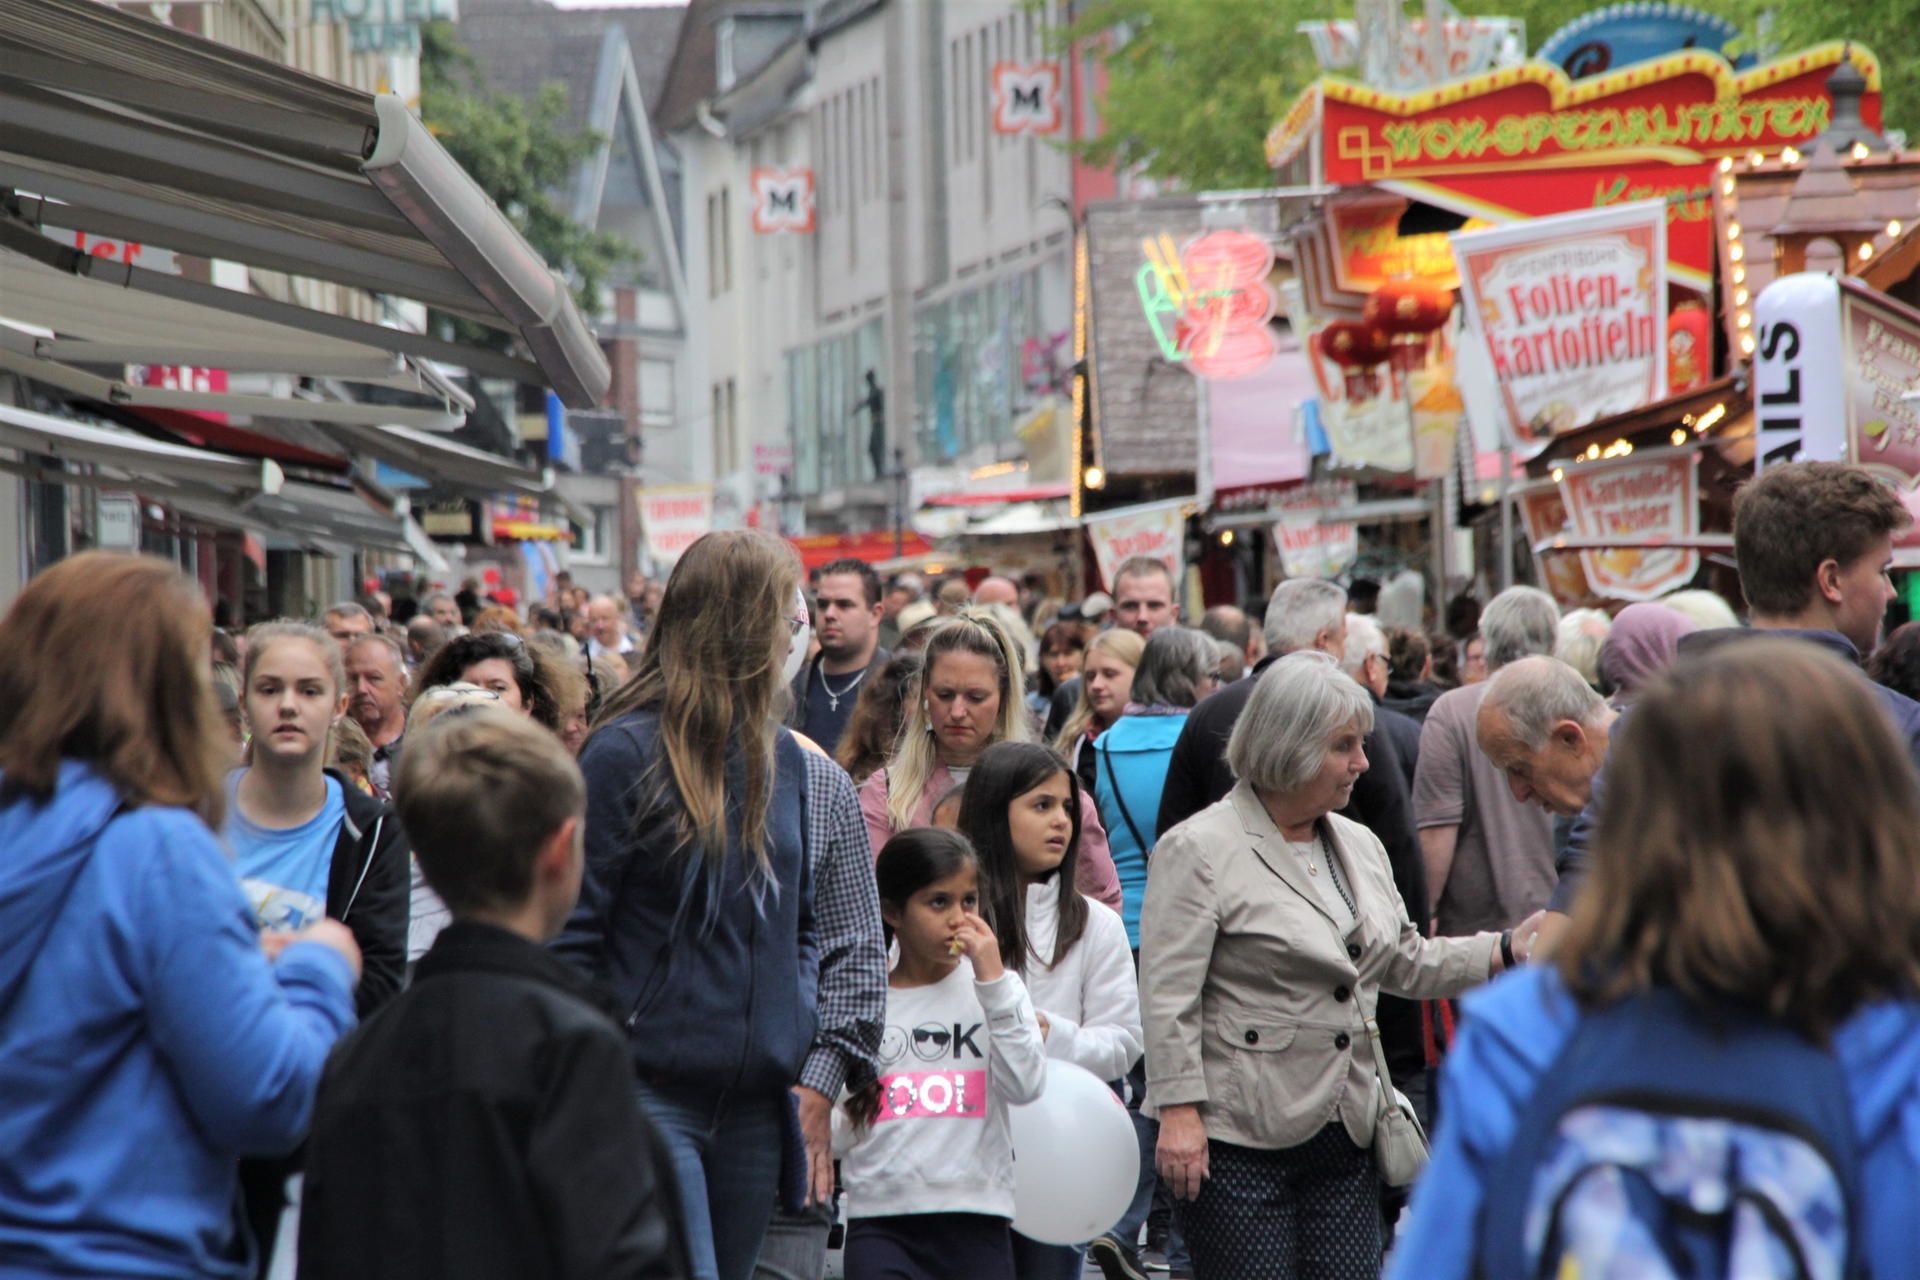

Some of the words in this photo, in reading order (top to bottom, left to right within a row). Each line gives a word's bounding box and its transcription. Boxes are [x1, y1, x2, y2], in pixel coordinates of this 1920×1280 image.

[1012, 86, 1040, 114] M
[769, 190, 795, 213] M
[1508, 271, 1632, 326] Folien-
